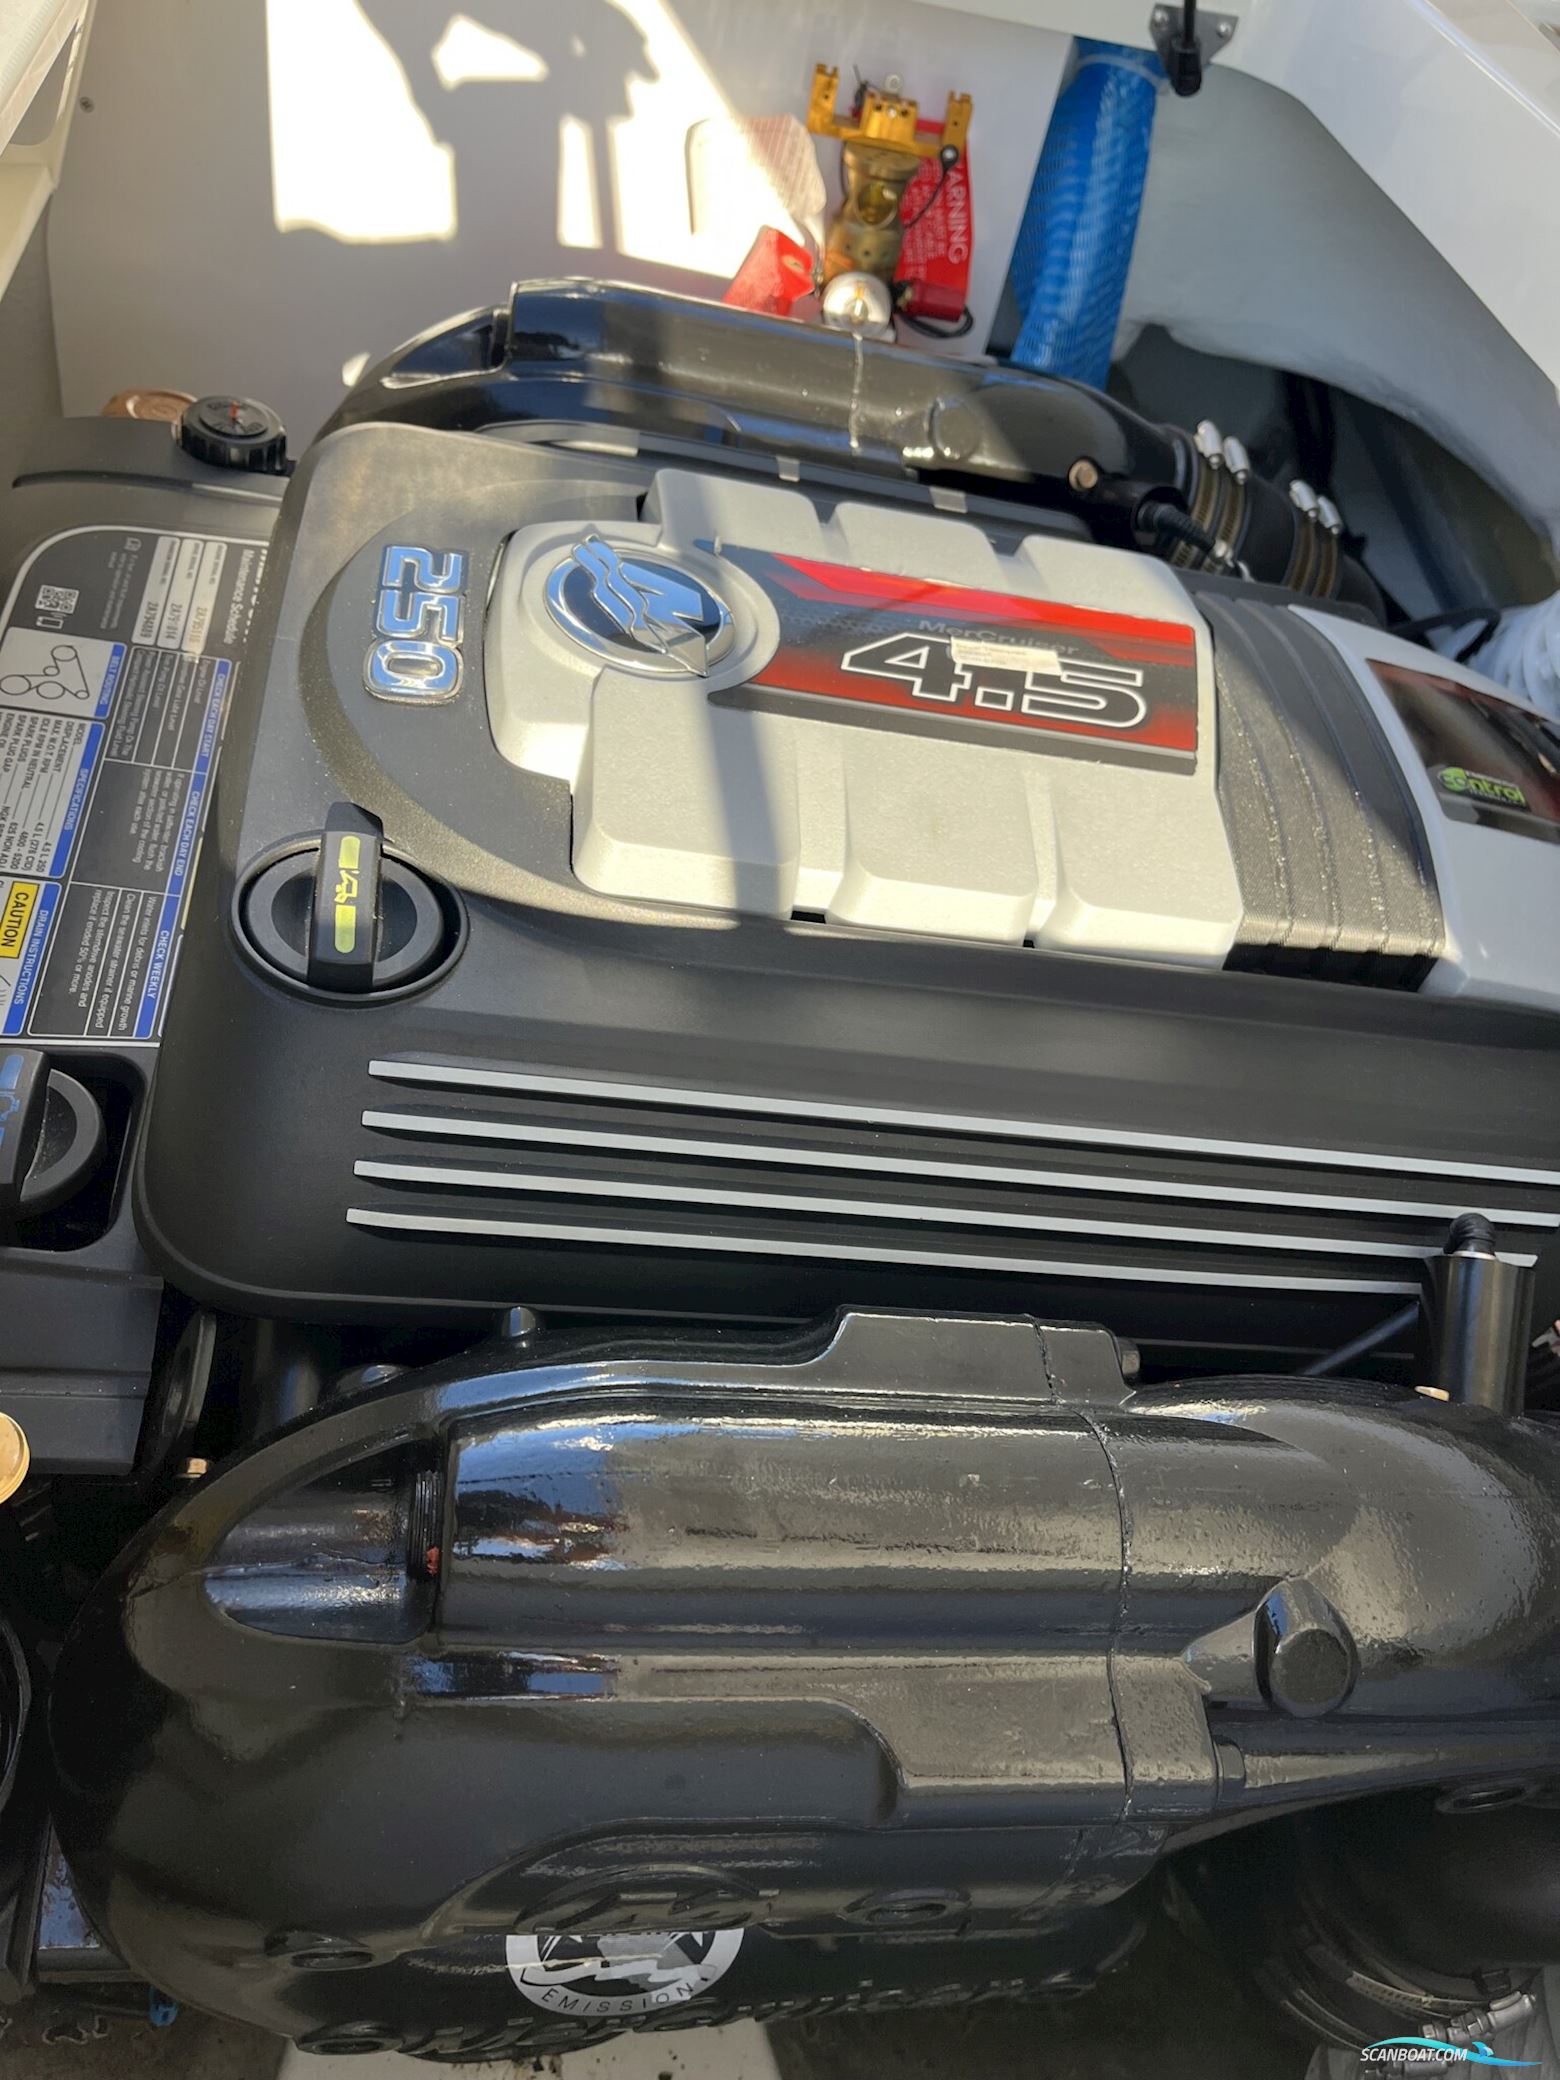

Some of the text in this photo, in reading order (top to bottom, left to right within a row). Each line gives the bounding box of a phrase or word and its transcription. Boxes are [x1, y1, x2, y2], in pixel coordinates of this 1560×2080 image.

[946, 166, 968, 264] ARNING
[231, 549, 255, 602] Maintenance
[222, 601, 244, 645] Schedule
[364, 545, 467, 705] 250
[918, 620, 1079, 654] MerCruiser
[841, 632, 1147, 729] 4.5
[0, 712, 15, 737] ENGINE
[24, 716, 39, 738] SPARK
[38, 717, 50, 732] IDLE
[200, 673, 226, 757] CHECK EACH DAY START
[0, 714, 26, 772] SPARK PLUG GAP
[33, 733, 45, 749] RPM
[52, 721, 74, 772] DISPLACEMENT
[72, 722, 86, 745] MODEL
[16, 739, 32, 762] PLUGS
[20, 757, 38, 789] NEUTRAL
[38, 757, 51, 773] RPM
[62, 767, 89, 831] SPECIFICATIONS
[33, 821, 44, 832] 4.5
[173, 790, 200, 876] CHECK EACH DAY END
[1, 835, 14, 851] NON
[40, 841, 52, 852] 4.5
[131, 840, 146, 863] cooling
[20, 855, 34, 870] CID)
[35, 859, 46, 872] 250
[87, 889, 103, 914] replace
[122, 893, 136, 913] Clean
[0, 892, 29, 947] CAUTION
[80, 921, 95, 945] eroded
[119, 914, 130, 925] the
[76, 946, 88, 962] 50%
[77, 890, 115, 1007] Inspect the sterndrive anodes and
[111, 926, 127, 958] seawater
[12, 909, 49, 1004] DRAIN INSTRUCTIONS
[74, 964, 83, 972] or
[115, 896, 156, 1030] Water inlets for debris or marine growth
[146, 930, 170, 999] CHECK WEEKLY
[104, 959, 119, 986] strainer
[92, 994, 111, 1028] equipped
[541, 1982, 693, 2012] EMISSION
